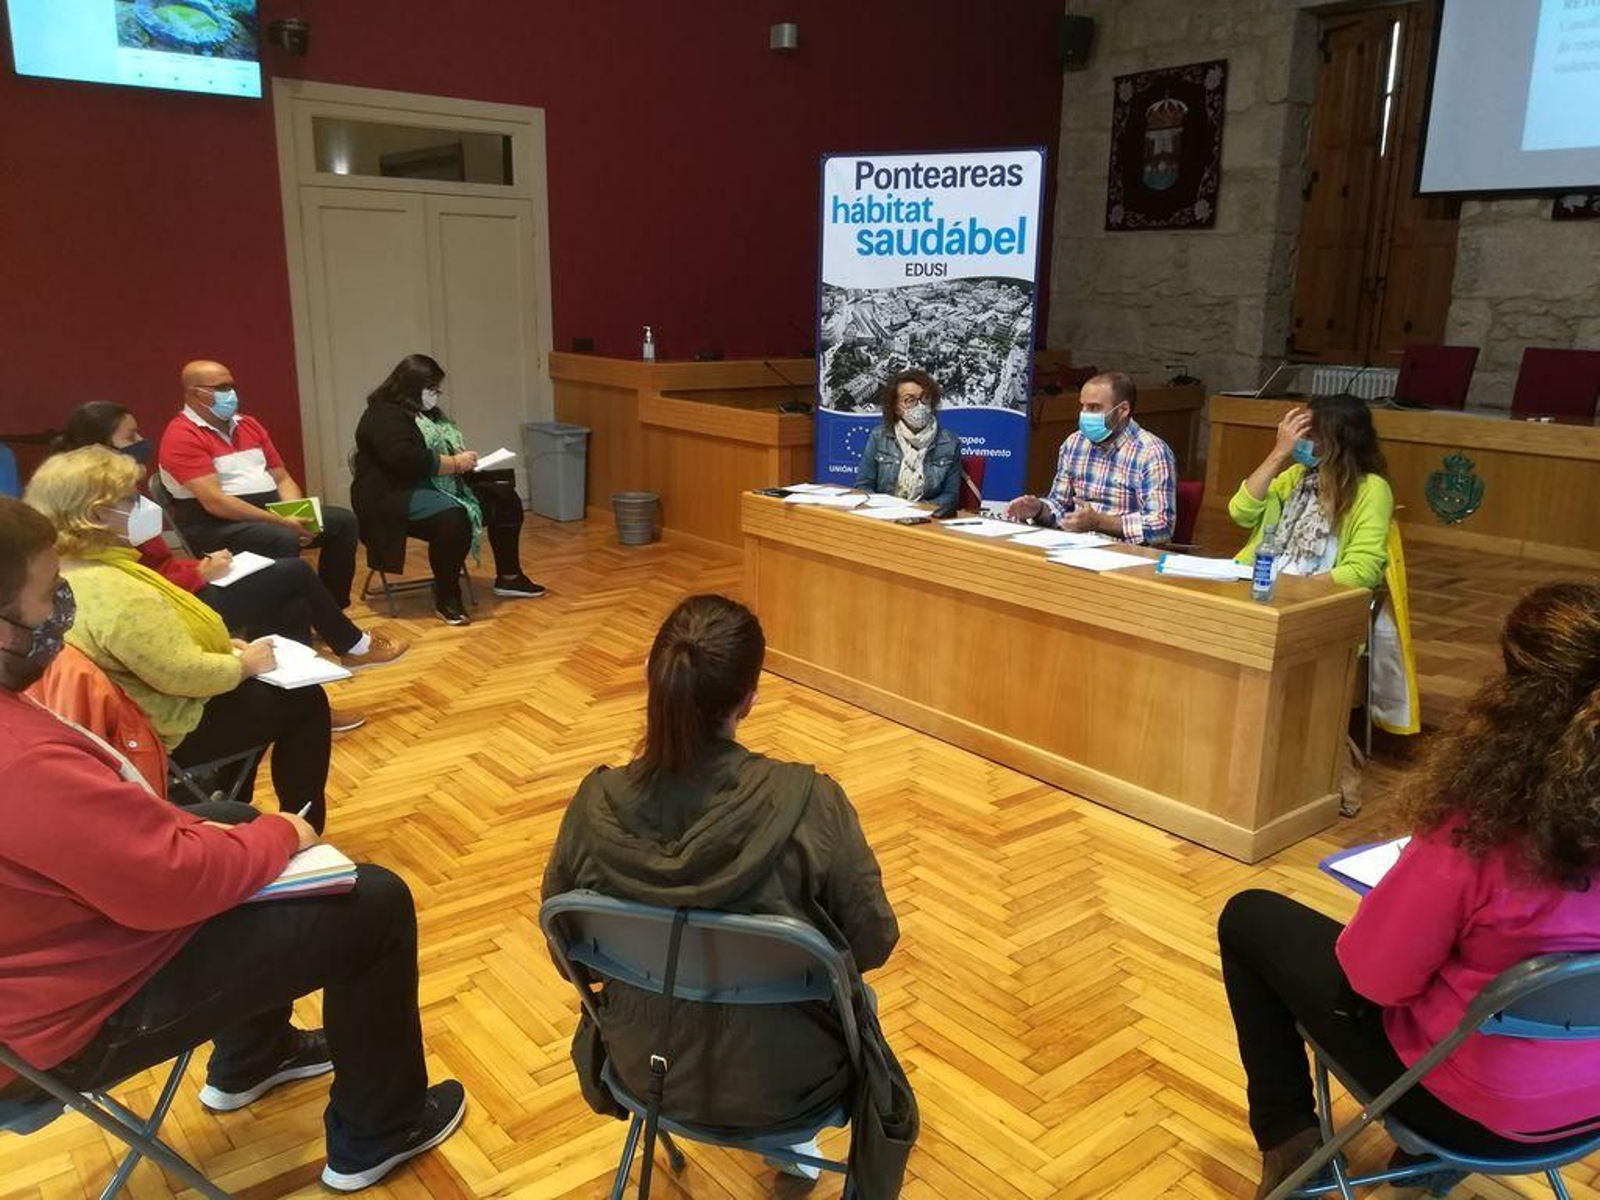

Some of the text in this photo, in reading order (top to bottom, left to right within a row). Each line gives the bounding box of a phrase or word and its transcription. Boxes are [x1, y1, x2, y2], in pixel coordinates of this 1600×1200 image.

[855, 161, 1024, 190] Ponteareas
[832, 193, 934, 224] hábitat
[856, 216, 1027, 256] saudábel
[905, 262, 948, 277] EDUSI
[828, 464, 853, 473] UNIÓN
